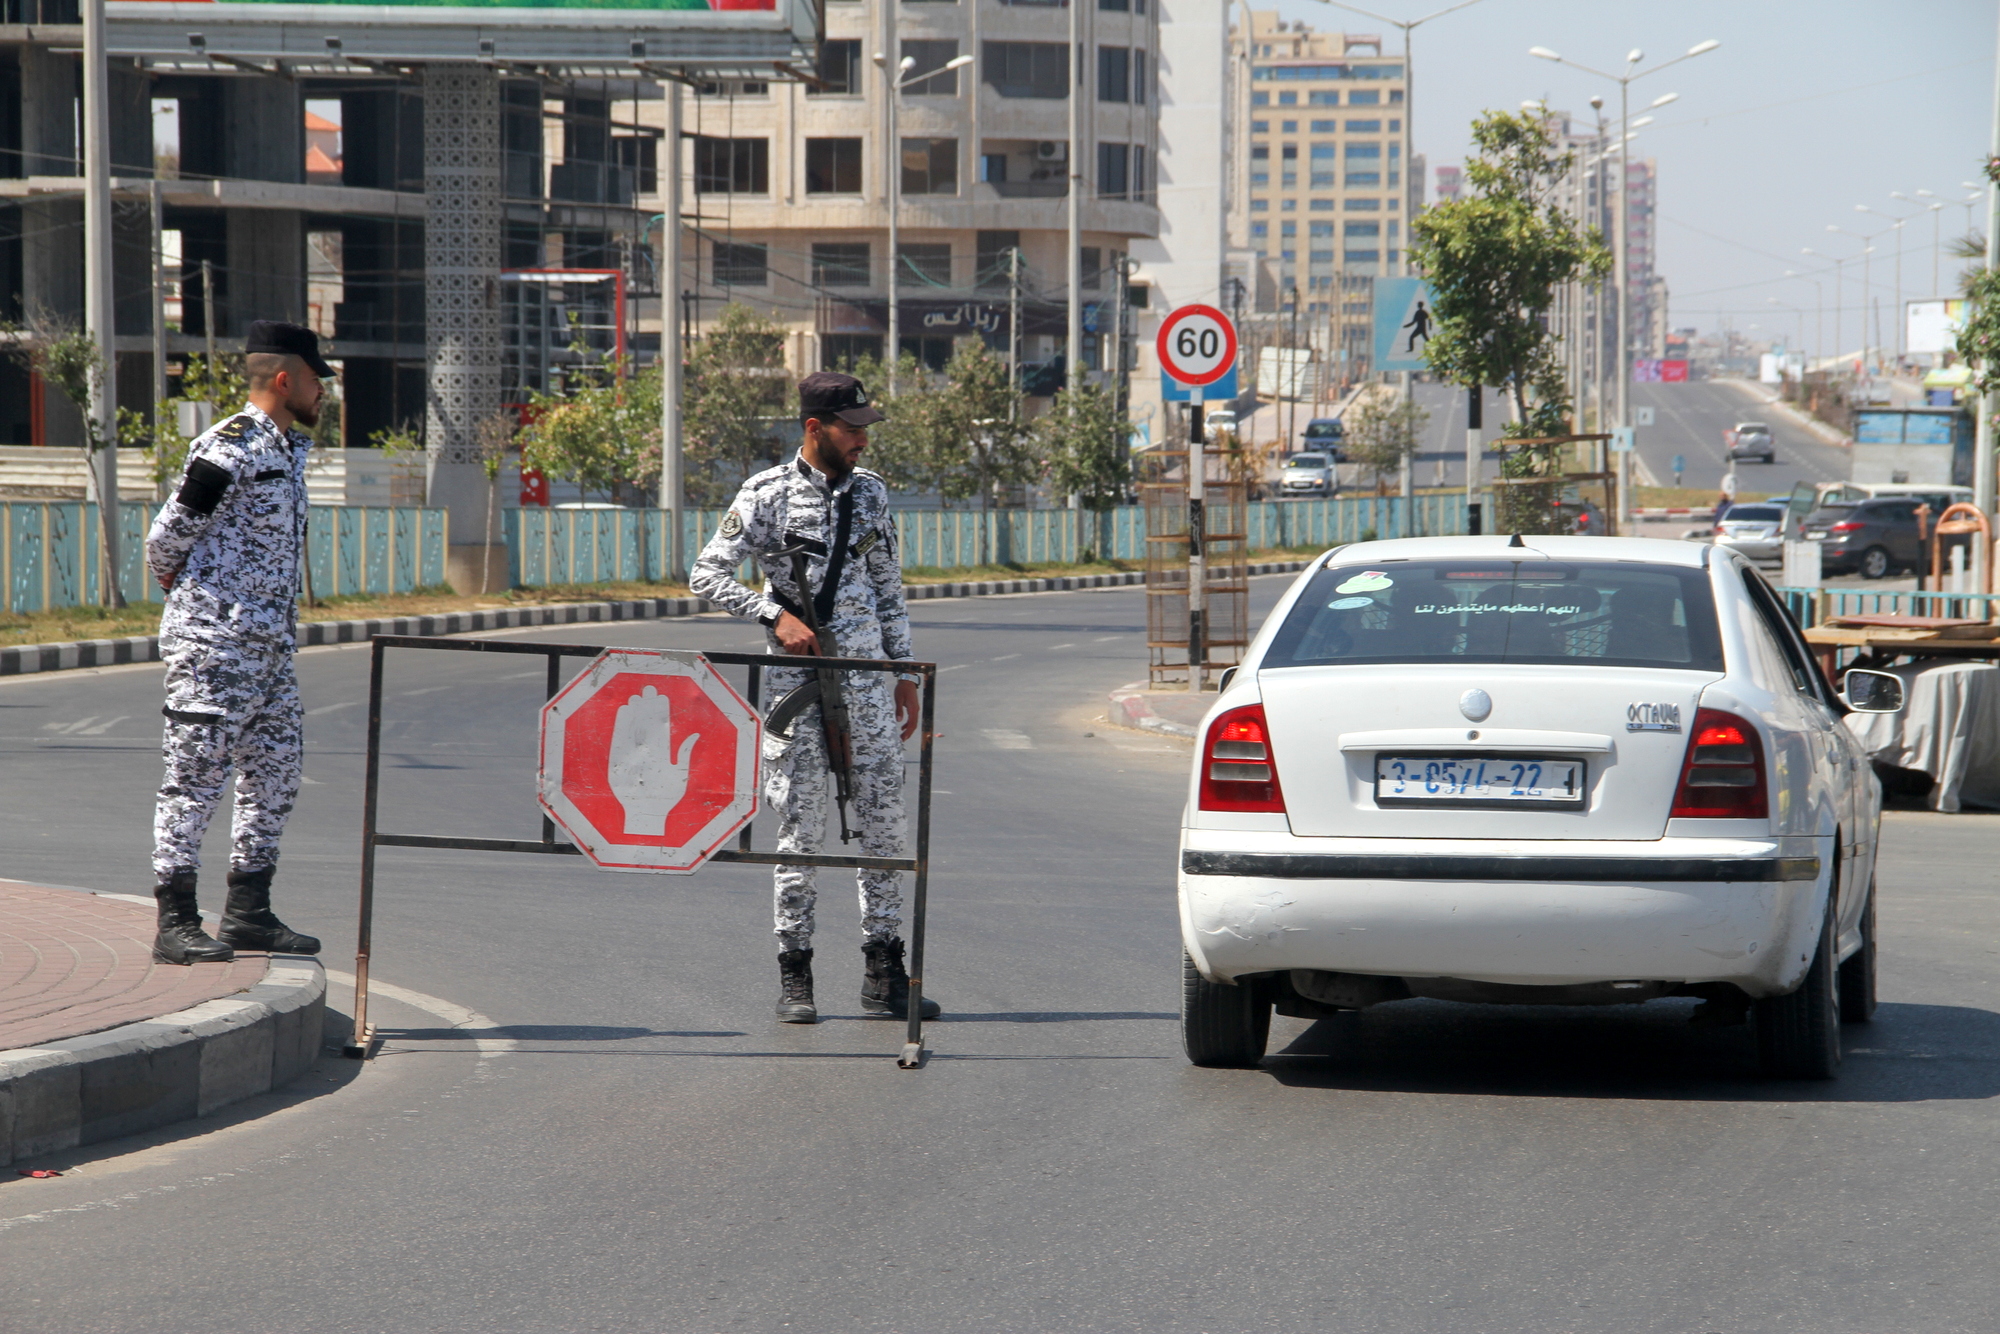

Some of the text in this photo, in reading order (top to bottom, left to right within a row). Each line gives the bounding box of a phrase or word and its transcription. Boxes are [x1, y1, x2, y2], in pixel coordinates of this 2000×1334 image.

[1177, 327, 1218, 358] 60
[1414, 604, 1435, 614] لنا
[1499, 602, 1544, 612] أعطهم
[1545, 605, 1581, 615] اللهم
